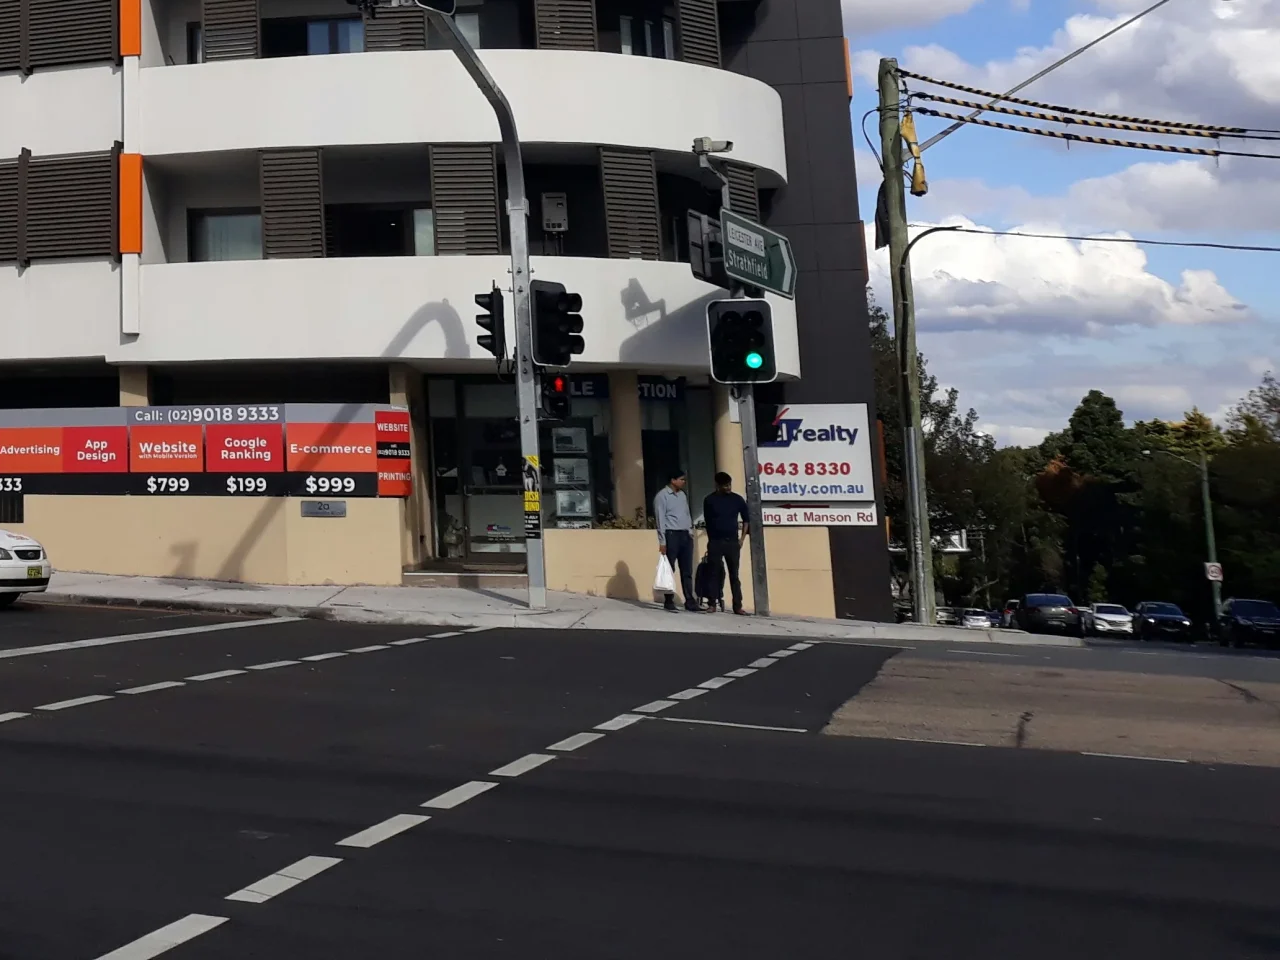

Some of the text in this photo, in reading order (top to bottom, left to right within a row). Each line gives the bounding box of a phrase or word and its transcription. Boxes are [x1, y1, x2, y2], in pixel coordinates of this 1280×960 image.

[728, 249, 768, 280] Strathfield
[135, 410, 163, 421] Call:
[237, 406, 280, 421] 9333
[377, 422, 409, 433] WEBSITE
[793, 425, 859, 445] realty
[85, 440, 108, 451] App
[139, 442, 197, 453] Website
[224, 437, 268, 449] Google
[290, 443, 373, 454] E-commerce
[0, 445, 61, 456] Advertising
[77, 451, 116, 462] Design
[221, 449, 272, 462] Ranking
[804, 461, 851, 476] 8330
[378, 472, 412, 481] PRINTING
[147, 476, 190, 494] $799
[226, 476, 267, 494] $199
[305, 475, 355, 494] $999
[761, 482, 864, 496] lrealty.com.au
[786, 513, 798, 522] at
[803, 511, 851, 522] Manson
[857, 512, 874, 522] Rd
